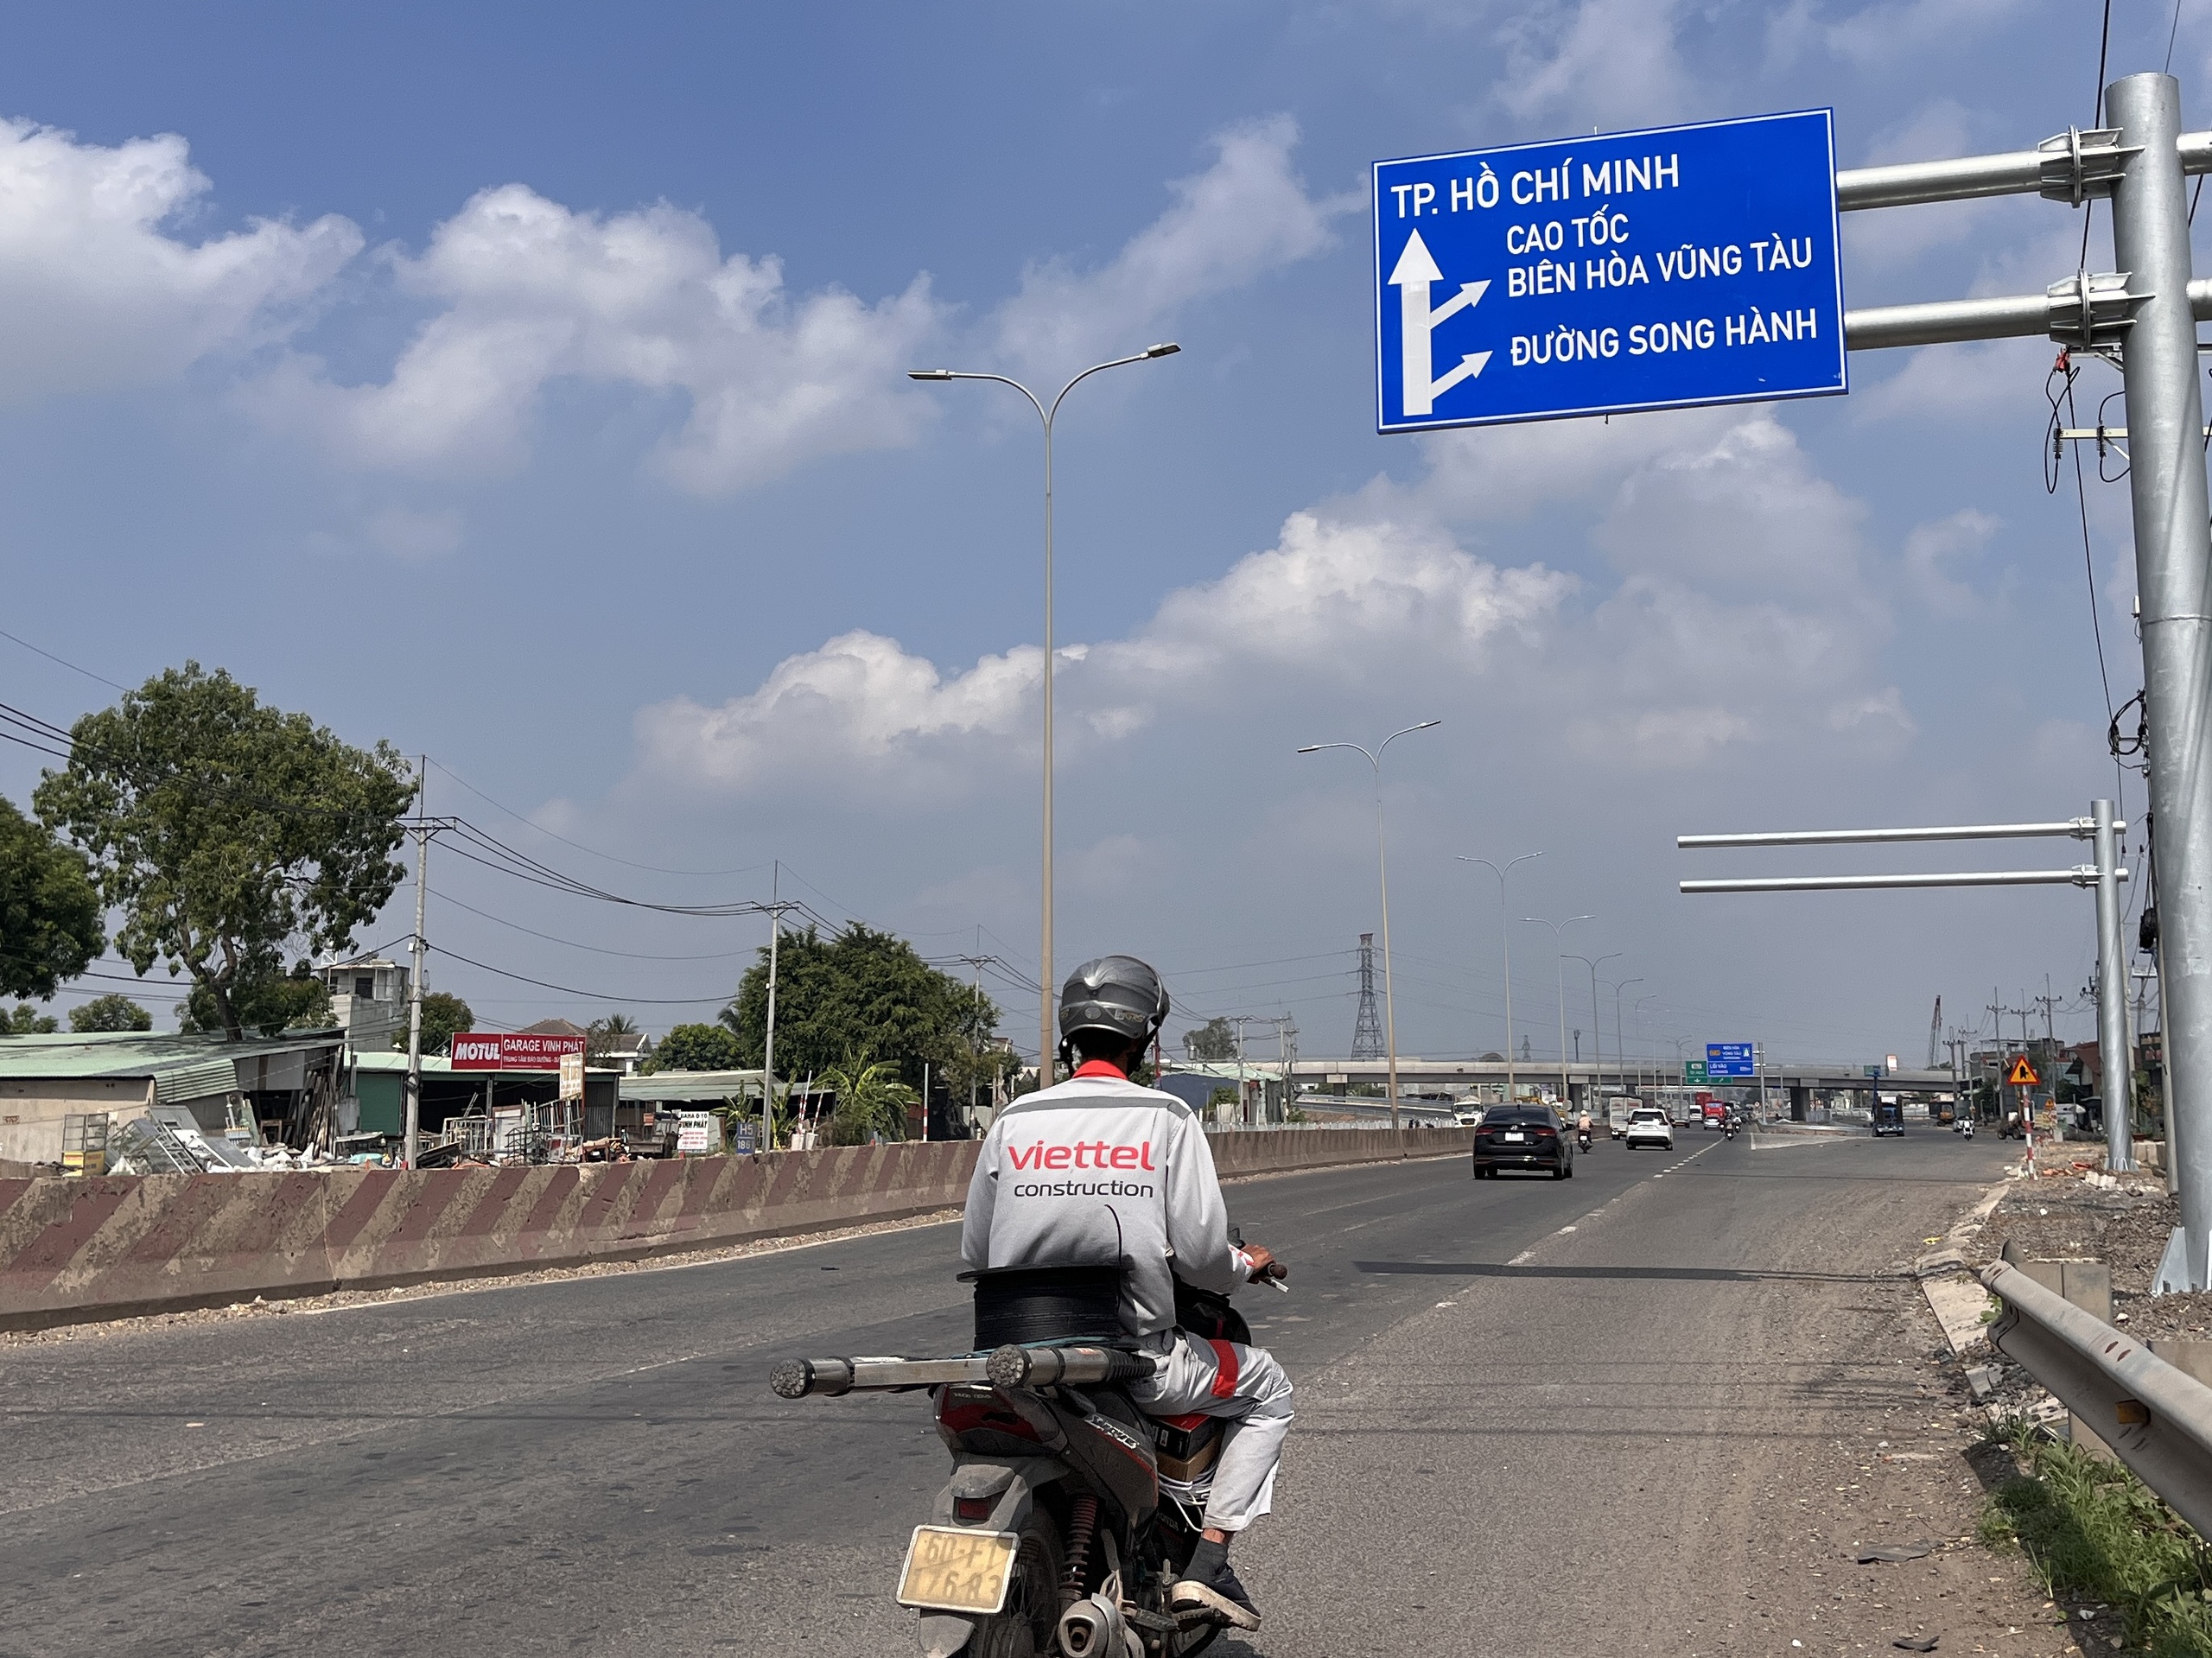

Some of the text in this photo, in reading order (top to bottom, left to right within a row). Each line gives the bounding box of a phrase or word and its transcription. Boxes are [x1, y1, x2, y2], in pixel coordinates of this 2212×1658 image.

[1390, 153, 1679, 219] TP. HỒ CHÍ MINH
[1507, 203, 1630, 255] CAO TỐC
[1508, 232, 1812, 298] BIÊN HÒA VŨNG TÀU
[1510, 306, 1817, 366] ĐƯỜNG SONG HÀNH
[454, 1043, 500, 1061] MOTUL
[504, 1039, 540, 1051] GARAGE
[563, 1039, 584, 1053] PHÁT
[740, 1123, 753, 1135] H5
[1007, 1140, 1156, 1172] viettel
[1014, 1179, 1154, 1198] construction
